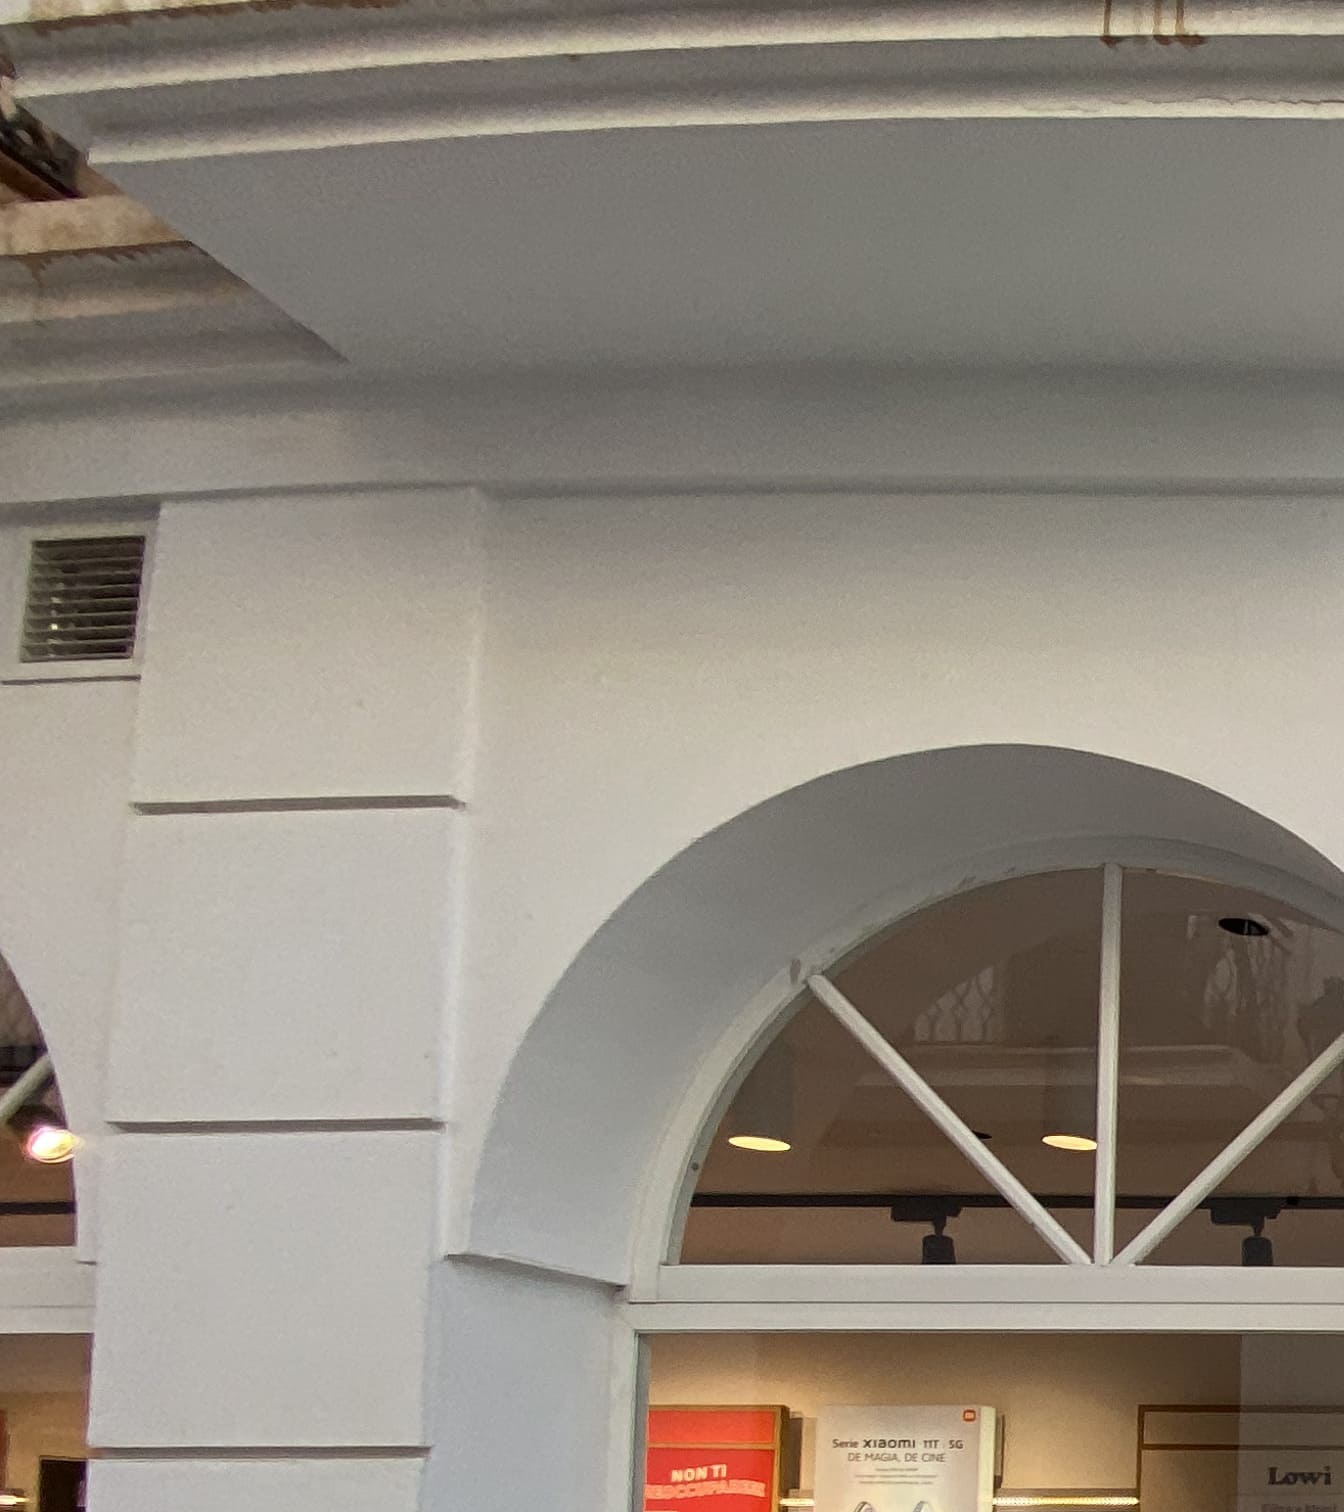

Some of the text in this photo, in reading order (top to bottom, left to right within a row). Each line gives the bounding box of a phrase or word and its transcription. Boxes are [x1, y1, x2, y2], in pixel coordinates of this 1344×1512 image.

[832, 1438, 859, 1448] Serie
[949, 1439, 964, 1449] 5G
[847, 1452, 861, 1462] DE
[904, 1452, 918, 1462] DE
[671, 1464, 727, 1482] NON TI
[1268, 1466, 1332, 1486] Lowi
